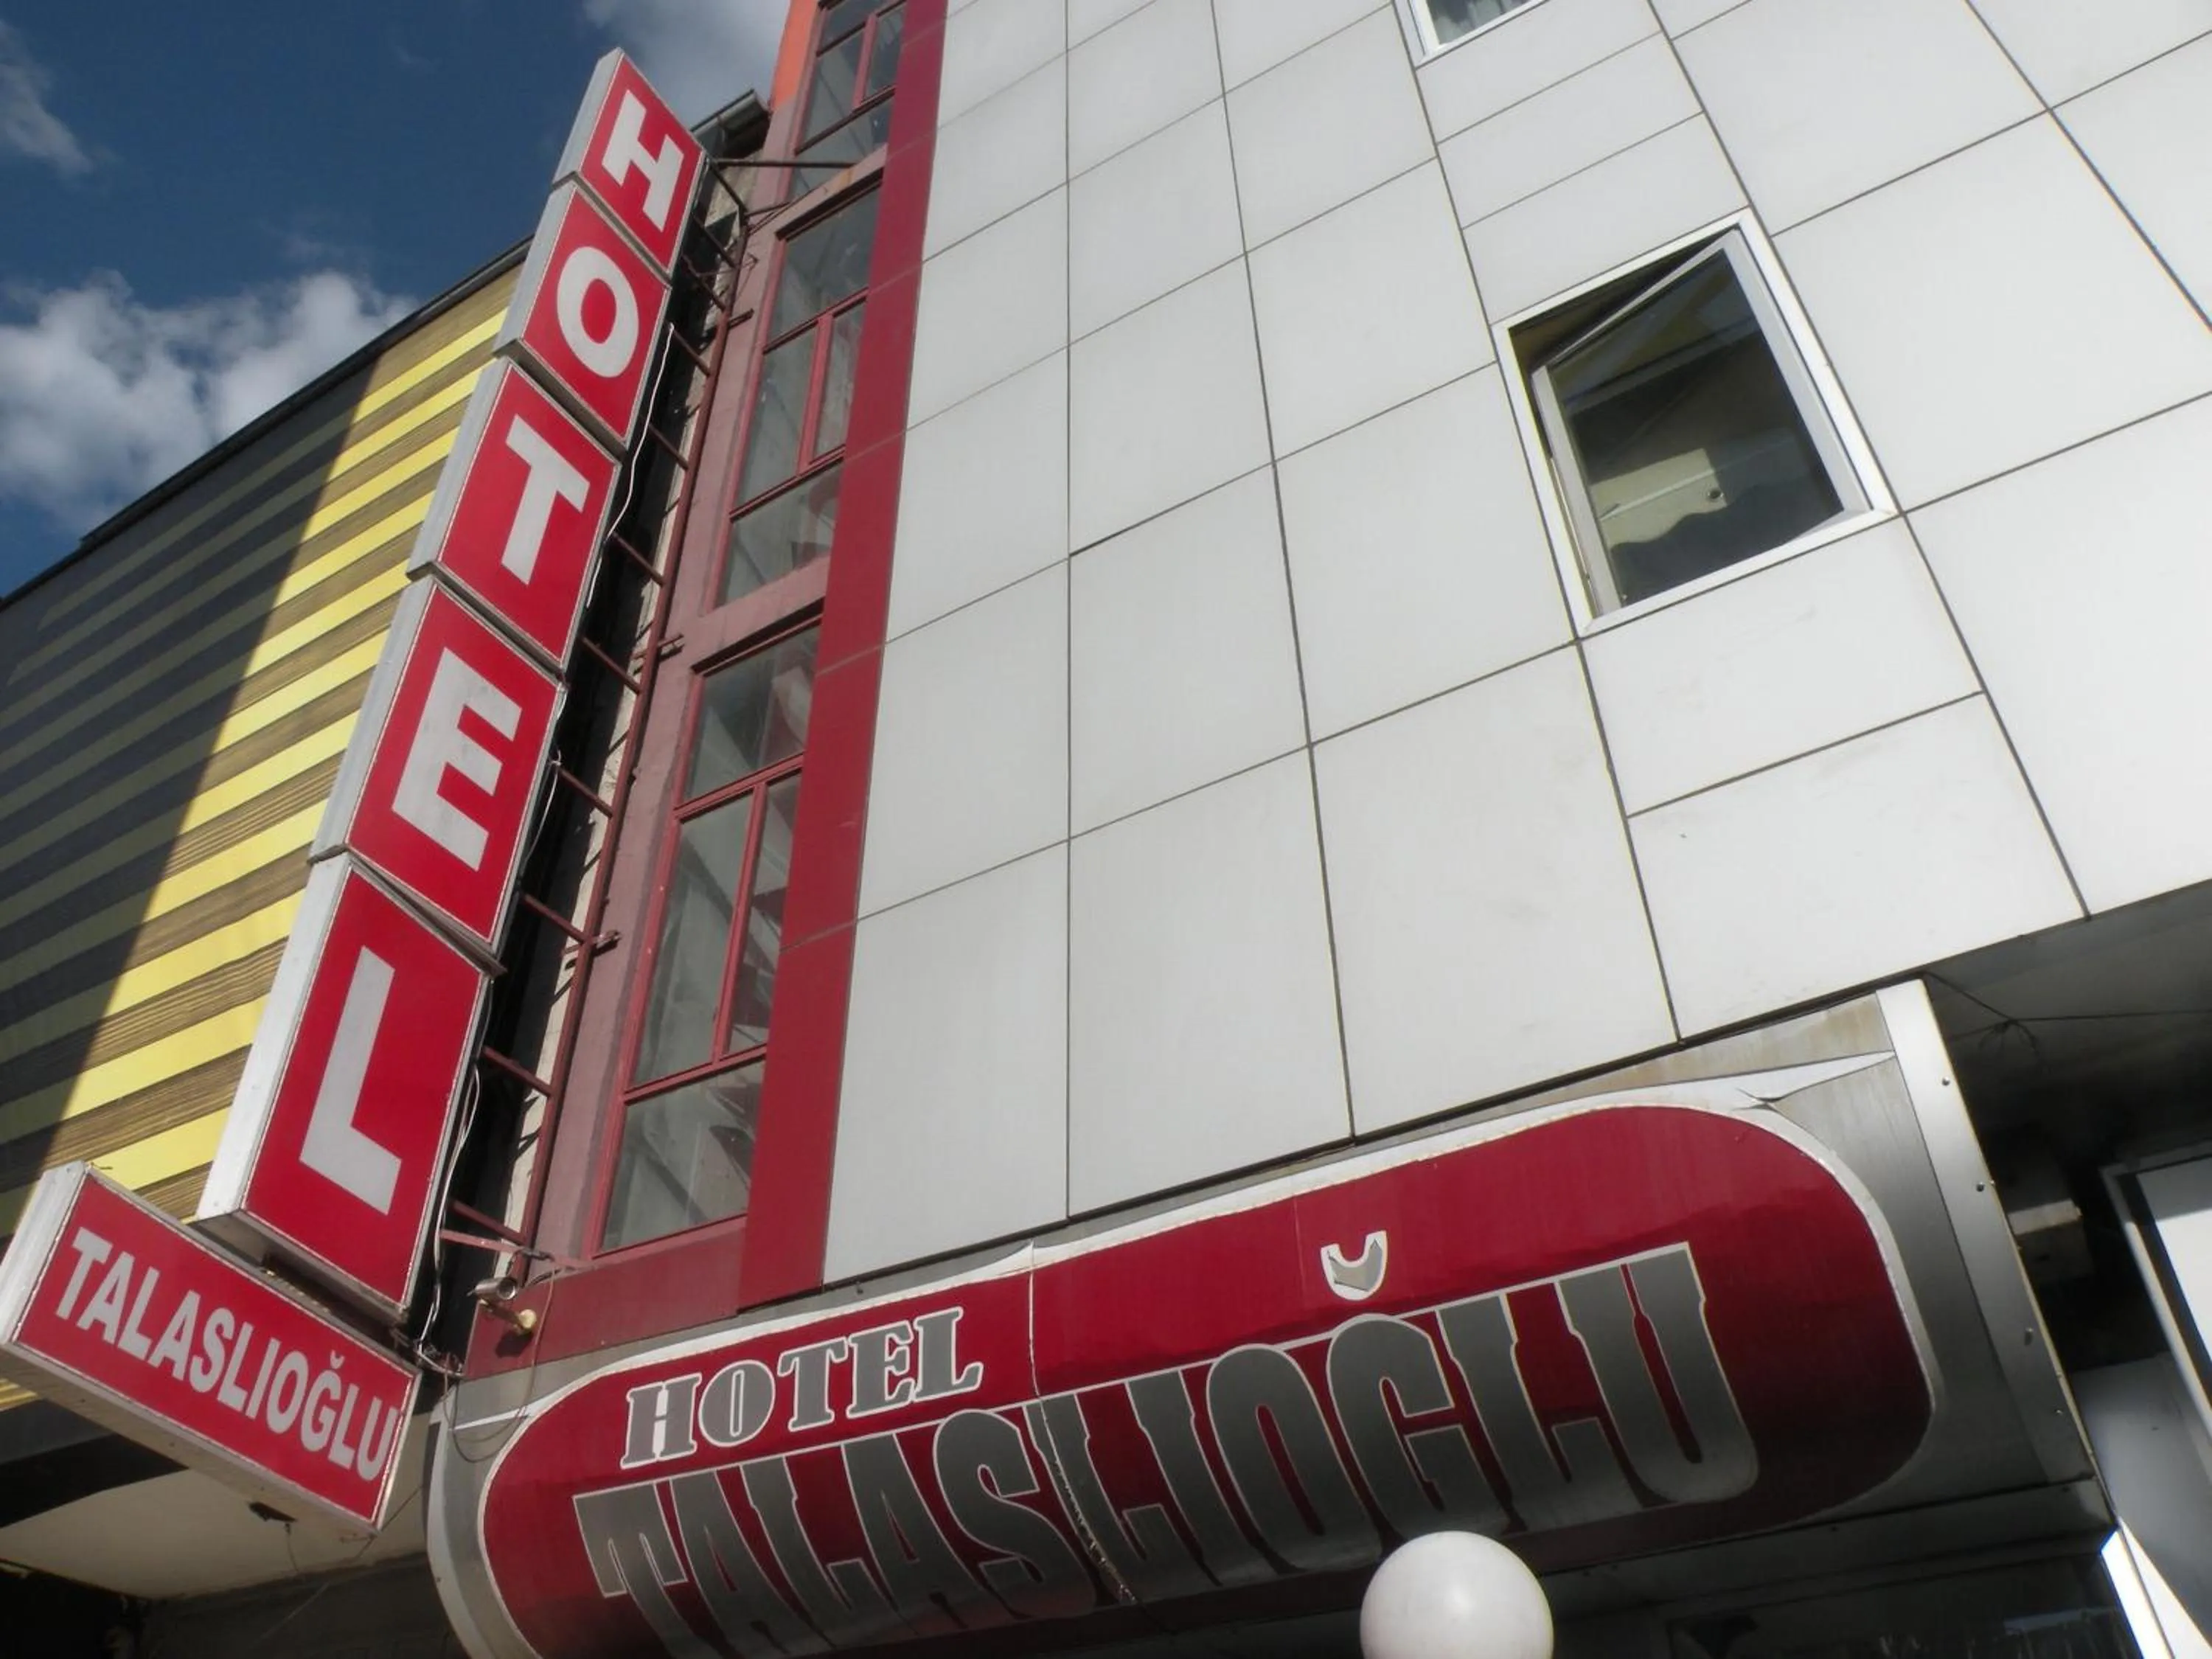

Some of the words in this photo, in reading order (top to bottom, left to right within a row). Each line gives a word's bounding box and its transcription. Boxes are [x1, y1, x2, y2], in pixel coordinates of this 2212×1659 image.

[299, 88, 684, 1216] HOTEL
[56, 1226, 400, 1481] TALASLIOĞLU
[572, 1231, 1760, 1659] TALASLIOĞLU
[619, 1307, 983, 1469] HOTEL
